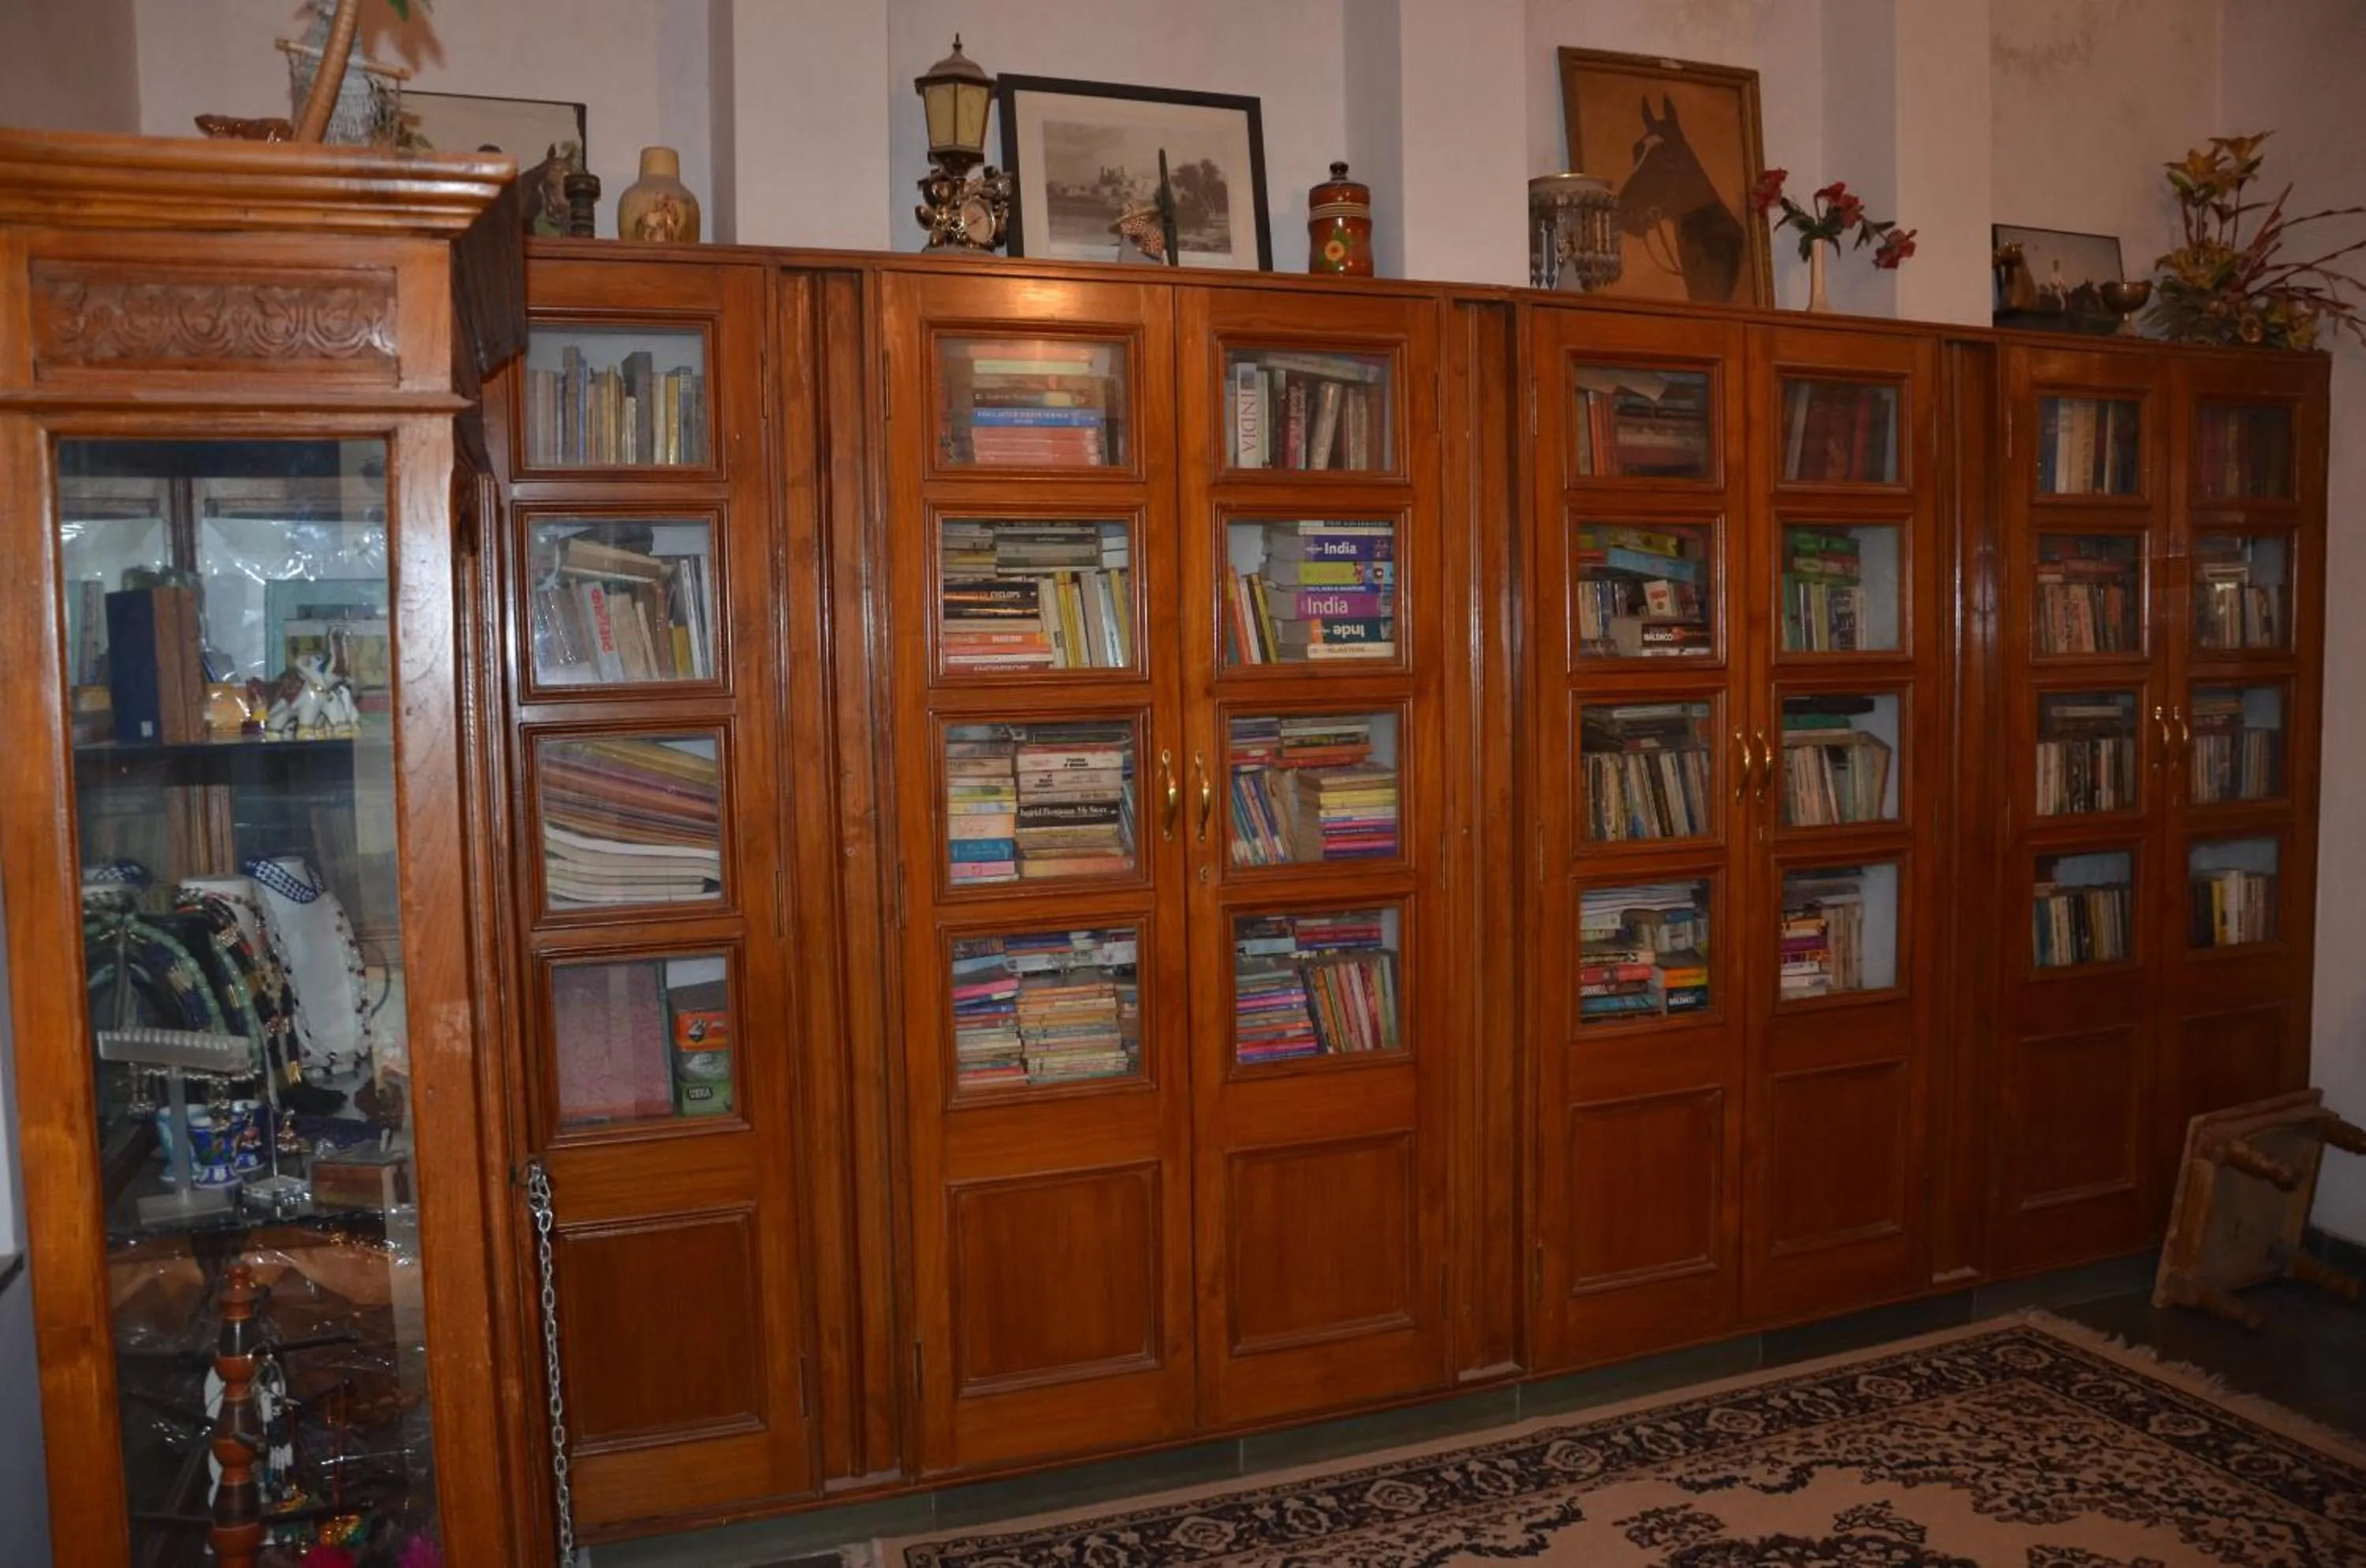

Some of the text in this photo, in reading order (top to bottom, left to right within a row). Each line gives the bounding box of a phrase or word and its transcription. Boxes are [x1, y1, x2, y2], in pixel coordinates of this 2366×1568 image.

[1241, 393, 1256, 453] INDIA
[1324, 542, 1357, 555] India
[1307, 595, 1349, 615] India
[1333, 624, 1364, 638] Inde
